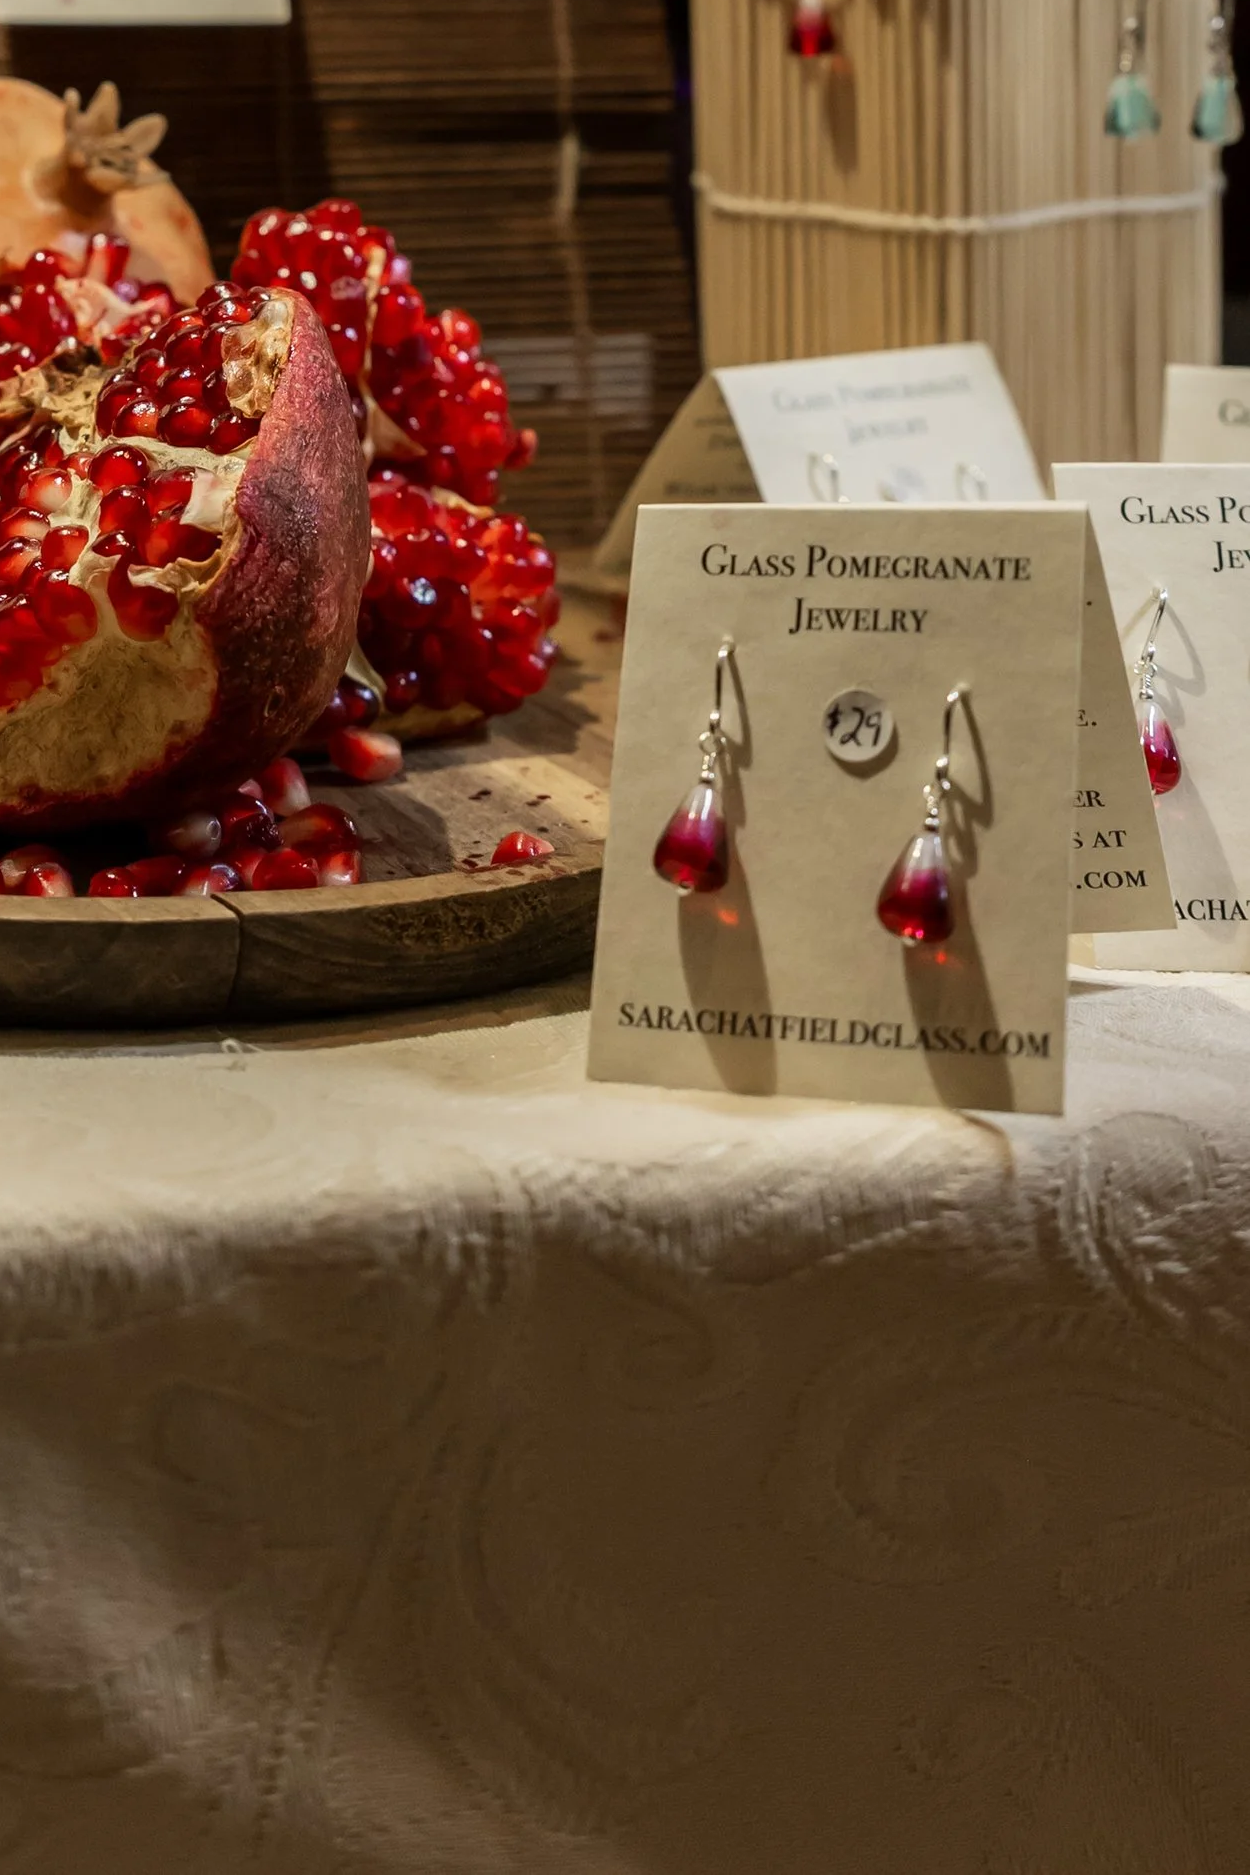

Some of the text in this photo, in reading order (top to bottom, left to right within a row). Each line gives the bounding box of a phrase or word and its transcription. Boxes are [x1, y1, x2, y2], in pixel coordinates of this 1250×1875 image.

[1121, 496, 1210, 524] GLASS
[701, 544, 1032, 581] GLASS POMEGRANATE
[1213, 540, 1250, 573] JE
[789, 597, 928, 634] JEWELRY
[826, 703, 882, 746] $29
[1093, 830, 1126, 848] AT
[1175, 899, 1250, 921] ACHA
[619, 1002, 1051, 1058] SARACHATFIELDGLASS.COM
